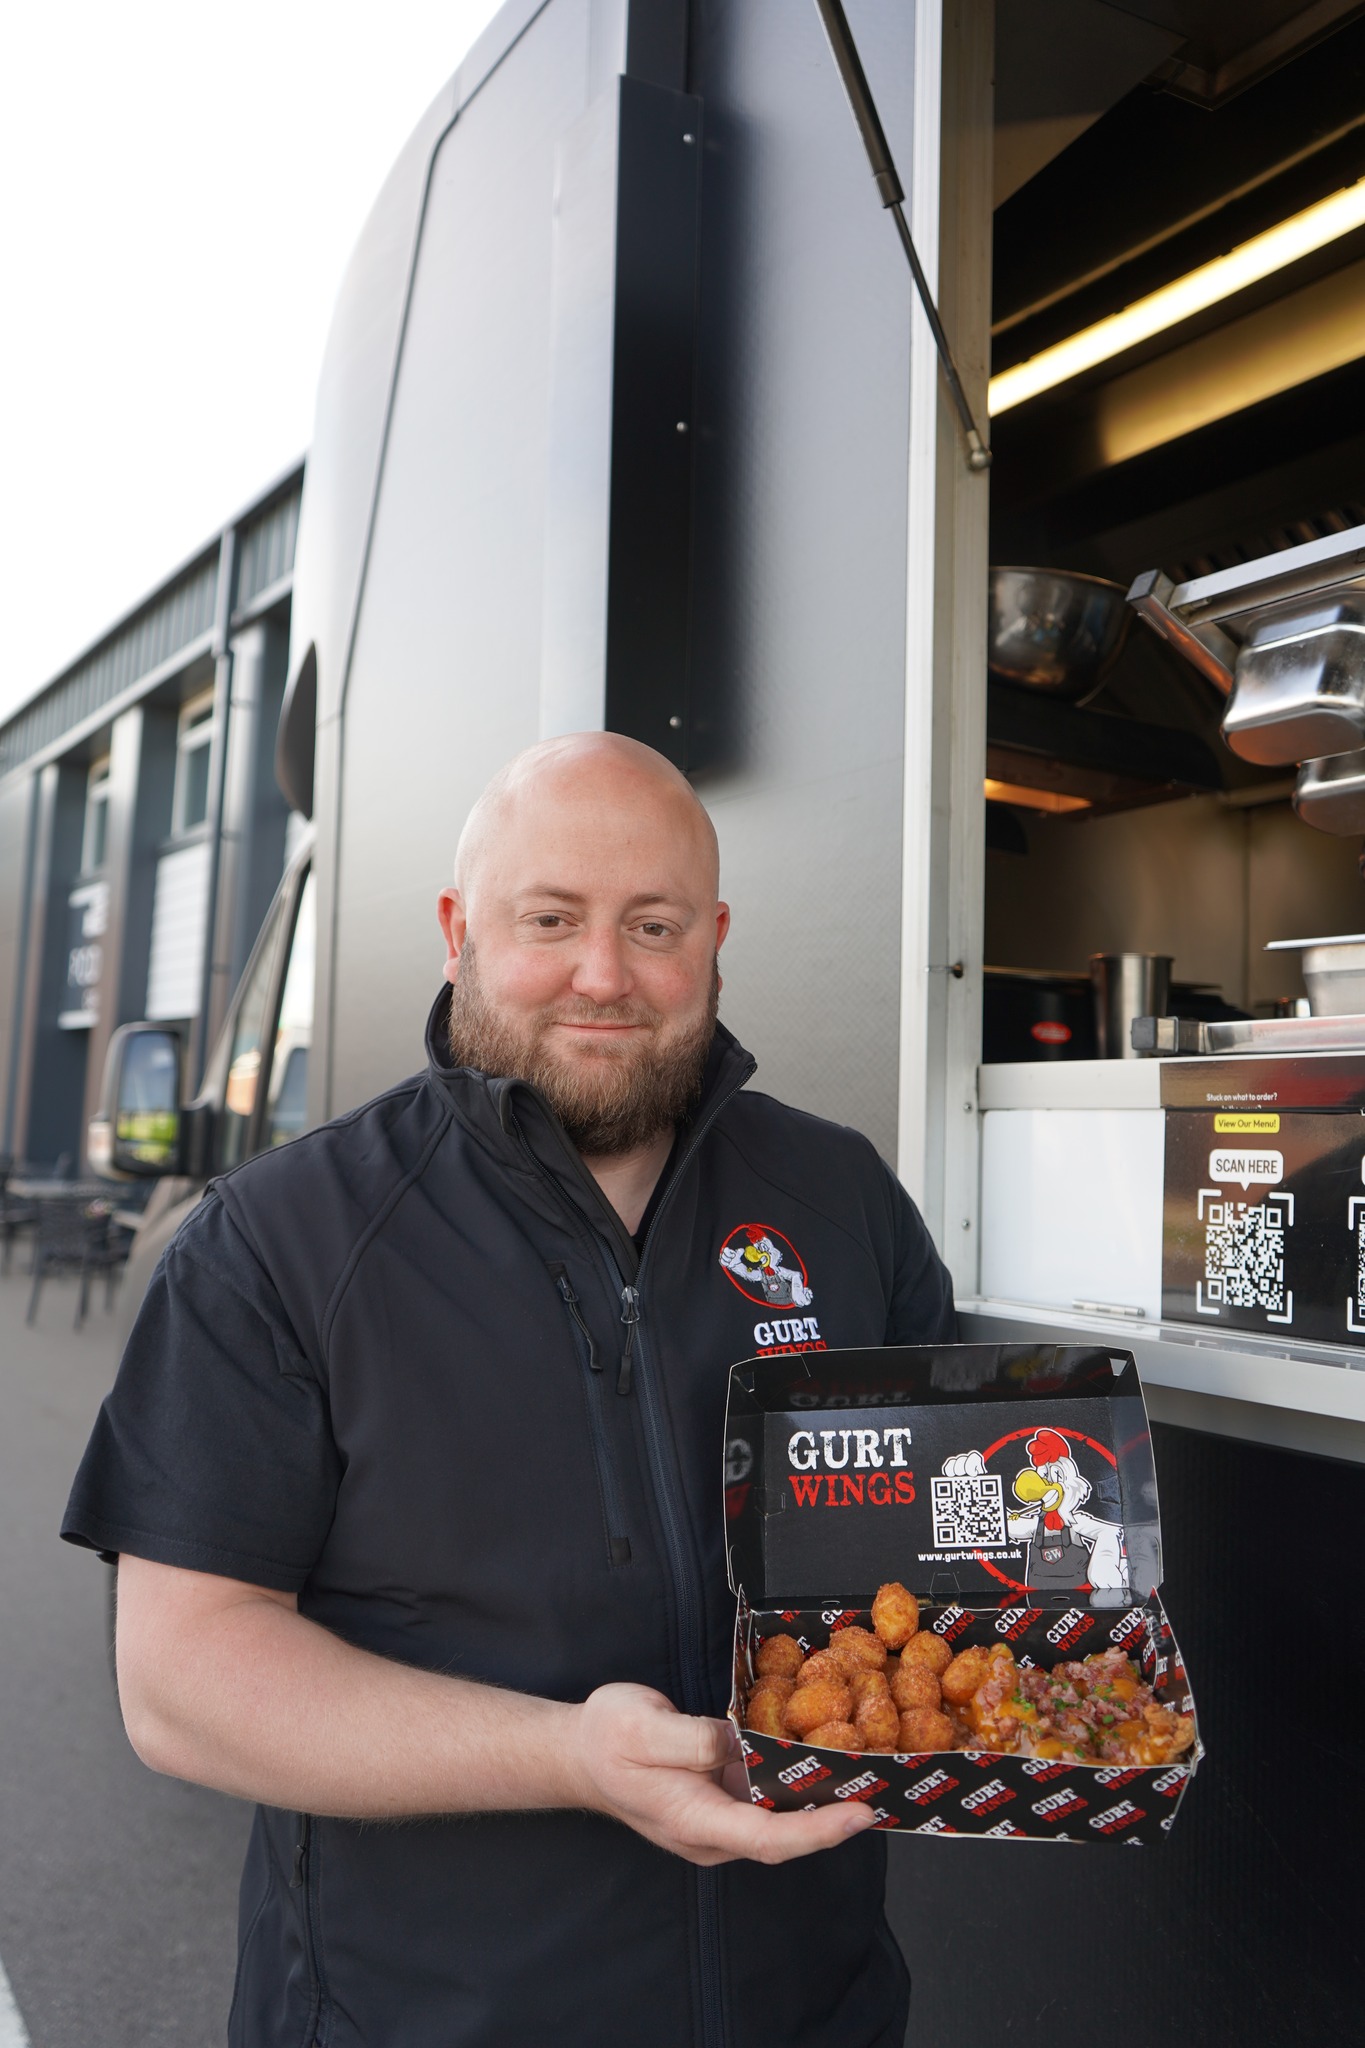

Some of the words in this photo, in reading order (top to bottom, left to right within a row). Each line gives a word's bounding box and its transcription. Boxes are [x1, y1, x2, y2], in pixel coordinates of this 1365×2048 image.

[1206, 1093, 1223, 1102] Stuck
[1233, 1092, 1248, 1101] what
[1249, 1093, 1255, 1101] to
[1256, 1092, 1278, 1101] order?
[1218, 1119, 1236, 1128] View
[1237, 1119, 1252, 1128] Our
[1253, 1119, 1277, 1129] Menu!
[1215, 1158, 1245, 1173] SCAN
[1248, 1159, 1278, 1174] HERE
[753, 1317, 821, 1346] GURT
[788, 1427, 912, 1470] GURT
[788, 1471, 916, 1507] WINGS
[917, 1548, 1022, 1562] www.gurtwings.co.uk
[1044, 1548, 1061, 1562] GW
[932, 1606, 964, 1634] GUR
[943, 1611, 976, 1642] WING
[1046, 1607, 1085, 1644] GURT
[1056, 1614, 1095, 1652] WINGS
[777, 1755, 822, 1785] GURT
[788, 1765, 833, 1793] WINGS
[834, 1770, 879, 1799] GURT
[904, 1768, 949, 1800] GURT
[1152, 1765, 1191, 1792] GUR
[914, 1776, 960, 1806] WINGS
[960, 1778, 1007, 1810] GURT
[970, 1787, 1017, 1817] WINGS
[1031, 1787, 1078, 1816] GURT
[1041, 1797, 1089, 1823] WINGS
[1088, 1799, 1137, 1829] GURT
[1098, 1807, 1147, 1836] WINGS
